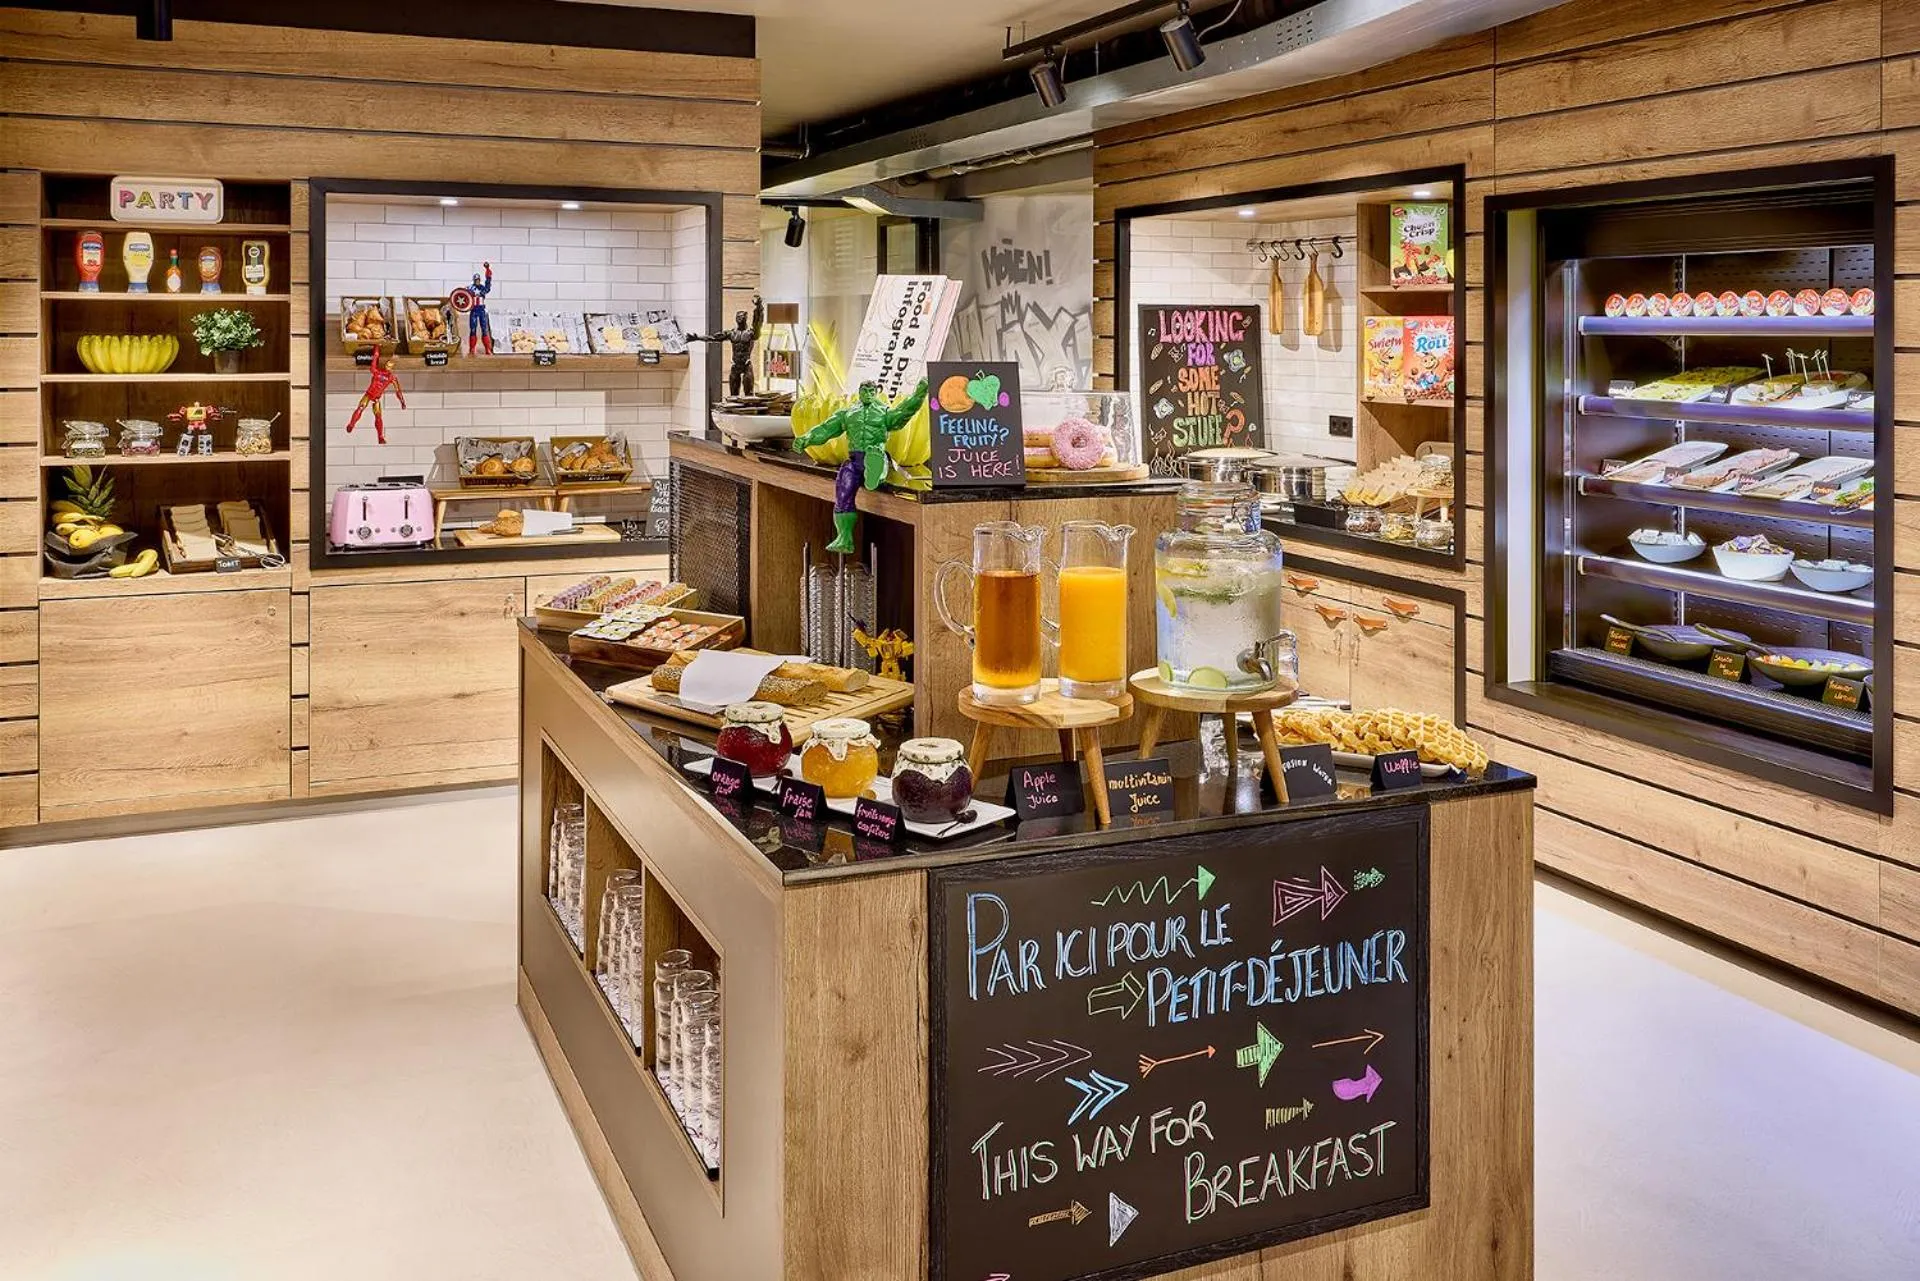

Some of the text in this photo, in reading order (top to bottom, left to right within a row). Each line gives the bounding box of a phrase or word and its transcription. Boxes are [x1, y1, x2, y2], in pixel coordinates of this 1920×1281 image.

[119, 190, 214, 210] PARTY
[909, 281, 932, 329] Food
[1158, 310, 1245, 343] LOOKING
[902, 336, 915, 350] &
[1186, 342, 1216, 367] FOR
[1178, 366, 1221, 393] SOME
[1187, 392, 1220, 416] HOT
[939, 413, 999, 435] FEELING
[953, 427, 1010, 450] FRUITY?
[938, 454, 1021, 479] IS HERE!
[947, 448, 1000, 463] JUICE
[1383, 758, 1419, 774] Waffle
[1023, 770, 1056, 792] Apple
[1108, 771, 1172, 790] multivitamin
[782, 788, 813, 808] fraise
[965, 892, 1234, 1001] PAR ICI POUR LE
[970, 1101, 1215, 1201] THIS WAY FOR
[1183, 1120, 1399, 1225] BREAKFAST
